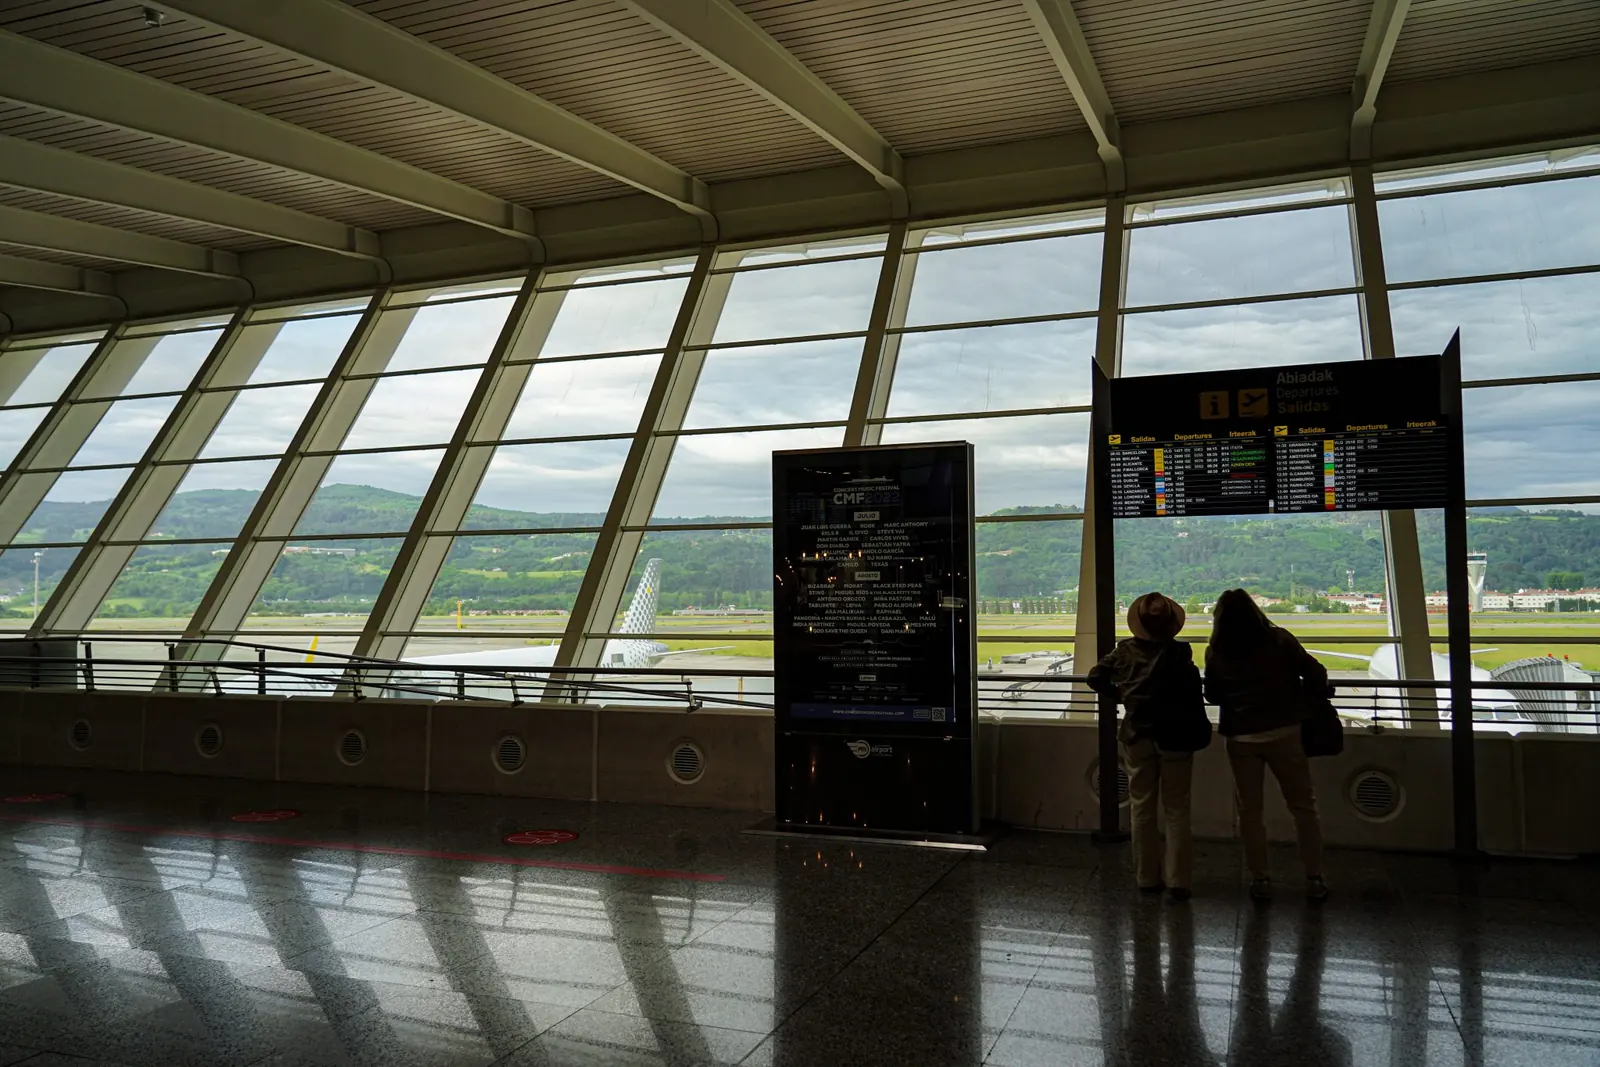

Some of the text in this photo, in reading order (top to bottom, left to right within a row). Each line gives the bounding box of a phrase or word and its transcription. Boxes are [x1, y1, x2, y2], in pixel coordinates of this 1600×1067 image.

[1276, 369, 1334, 385] Abiadak
[1276, 384, 1340, 399] Departures
[1276, 399, 1332, 415] Salidas
[1345, 423, 1389, 432] Departures
[1406, 420, 1437, 428] Irteerak
